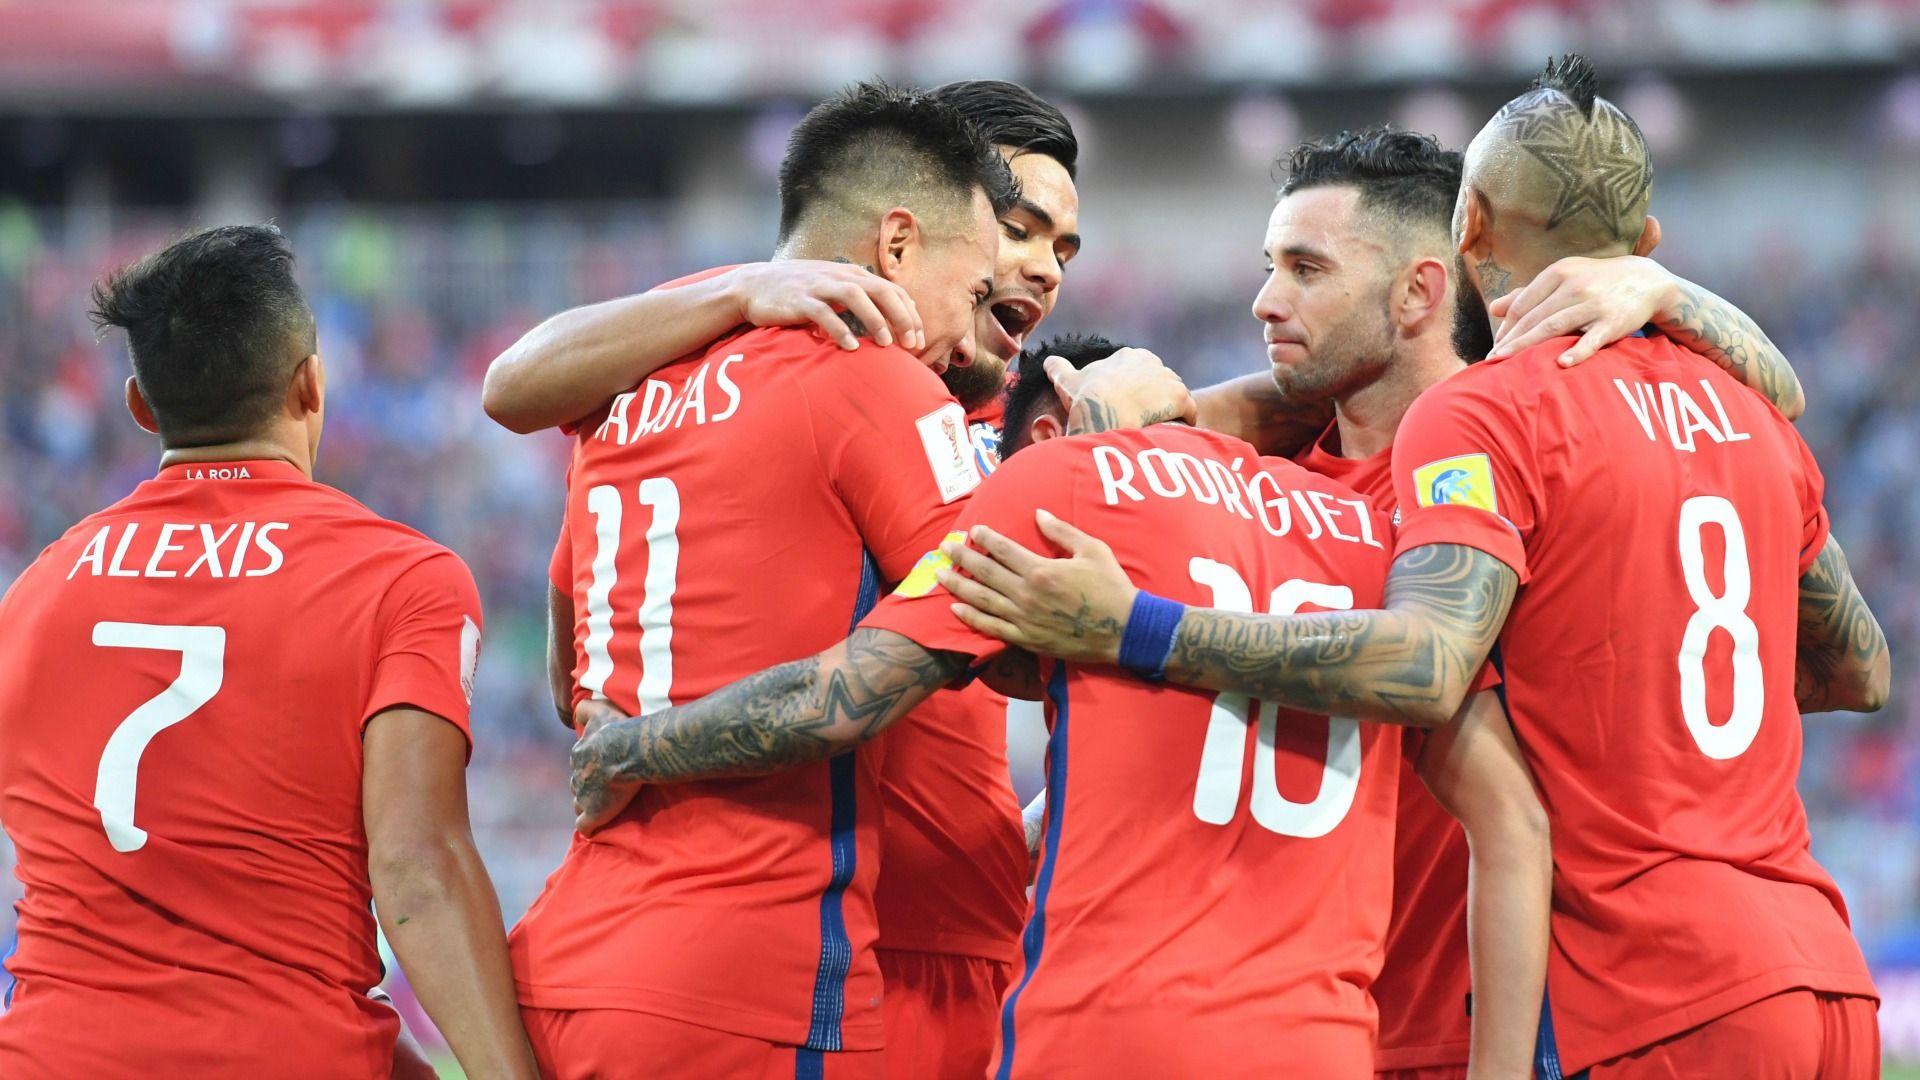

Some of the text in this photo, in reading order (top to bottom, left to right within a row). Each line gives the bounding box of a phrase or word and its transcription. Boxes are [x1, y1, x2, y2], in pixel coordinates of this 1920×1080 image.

[186, 466, 251, 480] LA ROJA
[594, 353, 744, 446] ARGAS
[1613, 378, 1752, 453] VIDAL
[66, 521, 289, 581] ALEXIS
[579, 476, 682, 718] 11
[1677, 495, 1765, 760] 8
[91, 620, 227, 853] 7
[1188, 556, 1363, 839] 10
